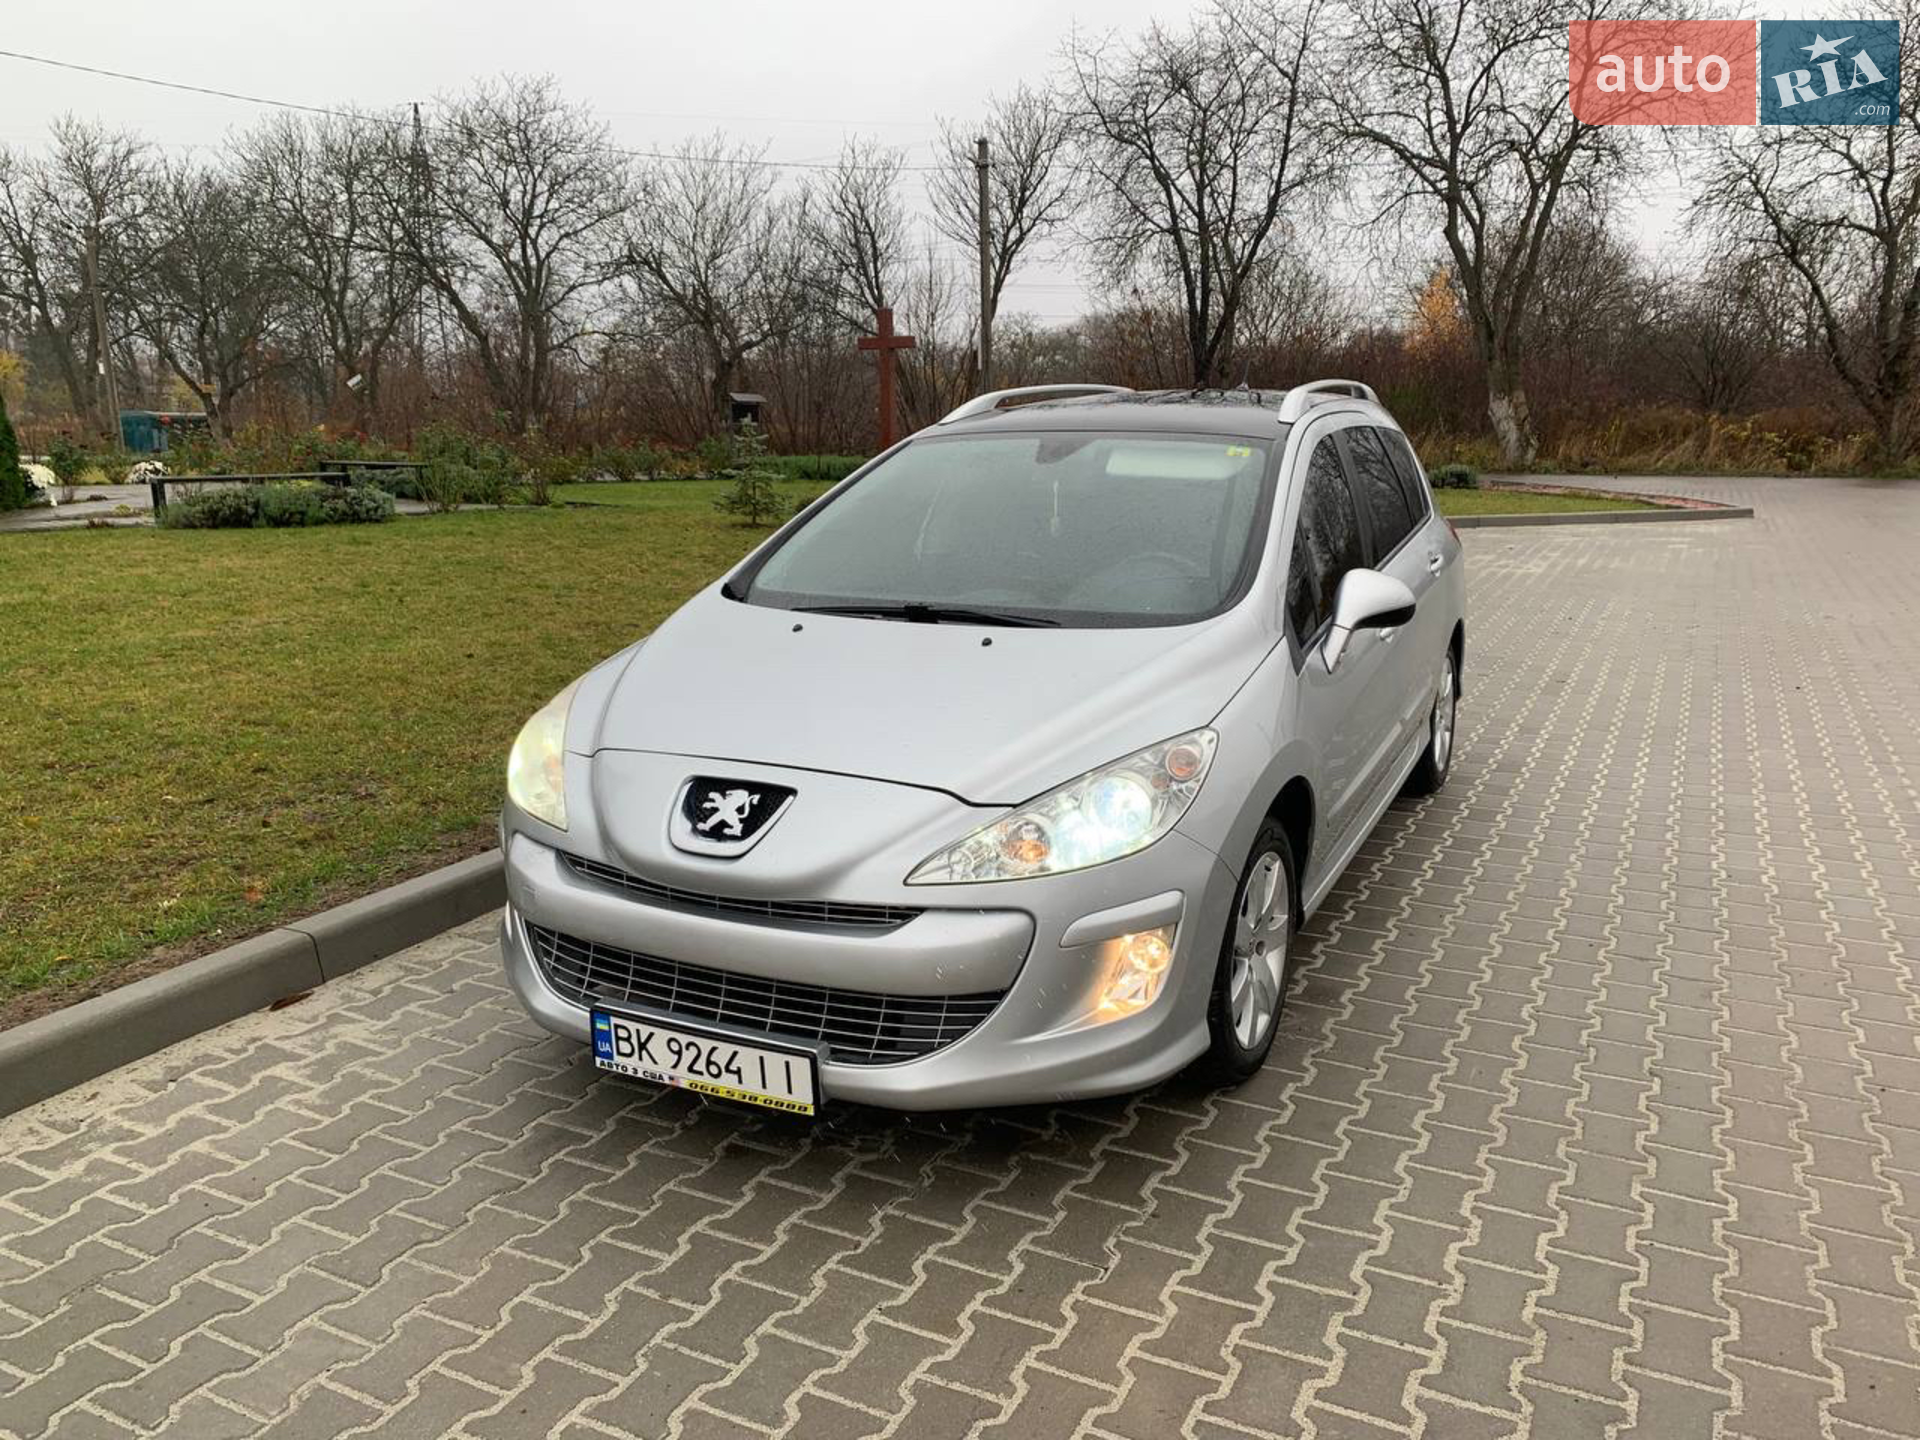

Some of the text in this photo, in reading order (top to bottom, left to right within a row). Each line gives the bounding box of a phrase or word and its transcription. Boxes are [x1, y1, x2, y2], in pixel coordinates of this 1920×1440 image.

[597, 1041, 612, 1054] UA
[613, 1023, 659, 1066] BK
[666, 1036, 743, 1085] 9264
[599, 1060, 629, 1073] АВТО
[642, 1070, 665, 1083] США
